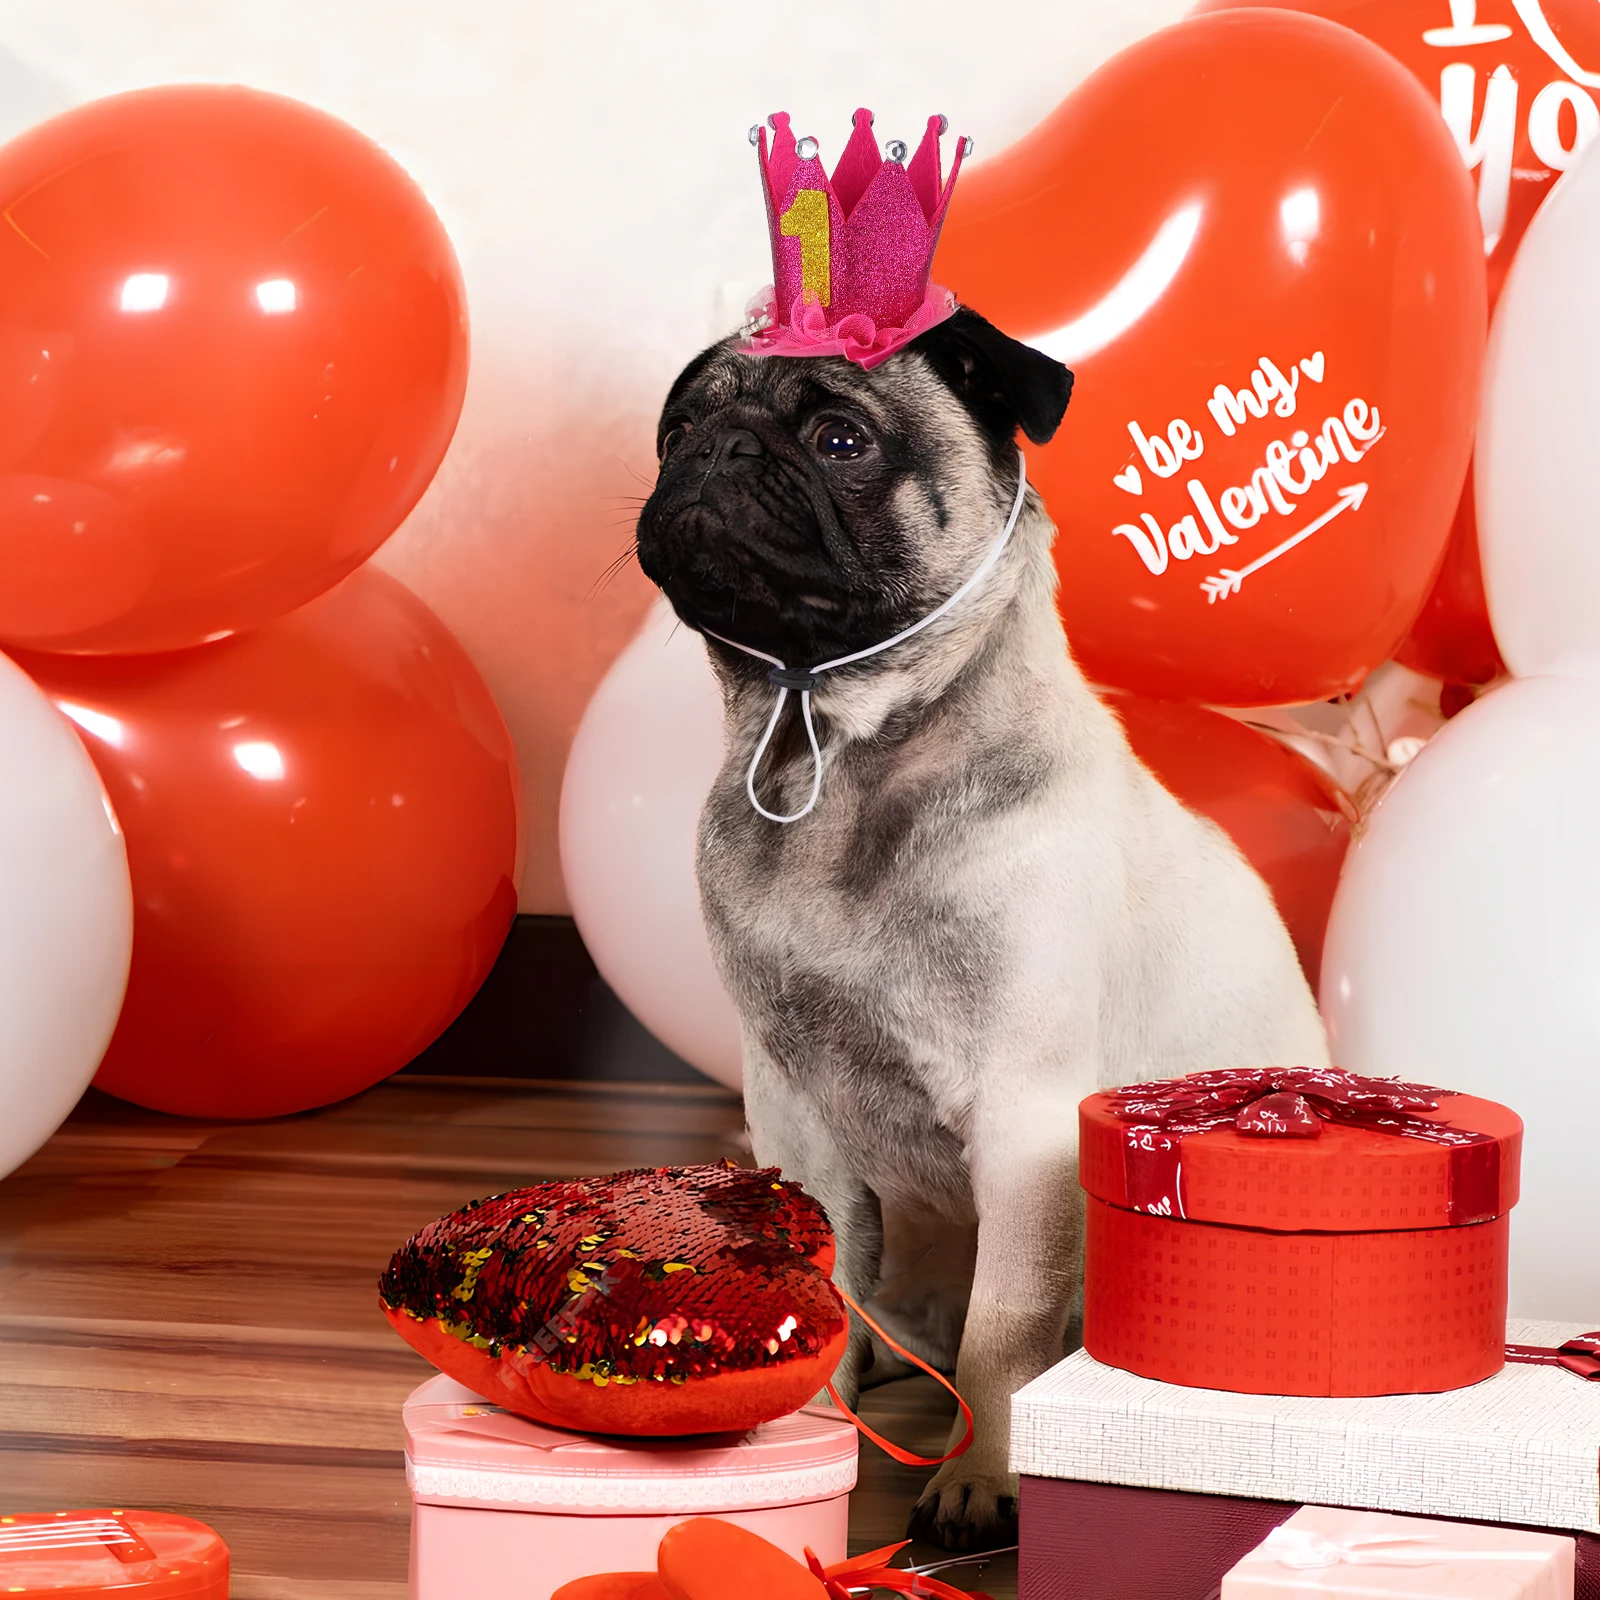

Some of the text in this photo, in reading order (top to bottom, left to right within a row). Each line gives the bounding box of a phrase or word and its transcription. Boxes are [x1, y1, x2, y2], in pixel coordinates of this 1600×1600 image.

[780, 188, 831, 307] 1
[1127, 356, 1299, 478] be my
[1111, 397, 1386, 576] Valentine
